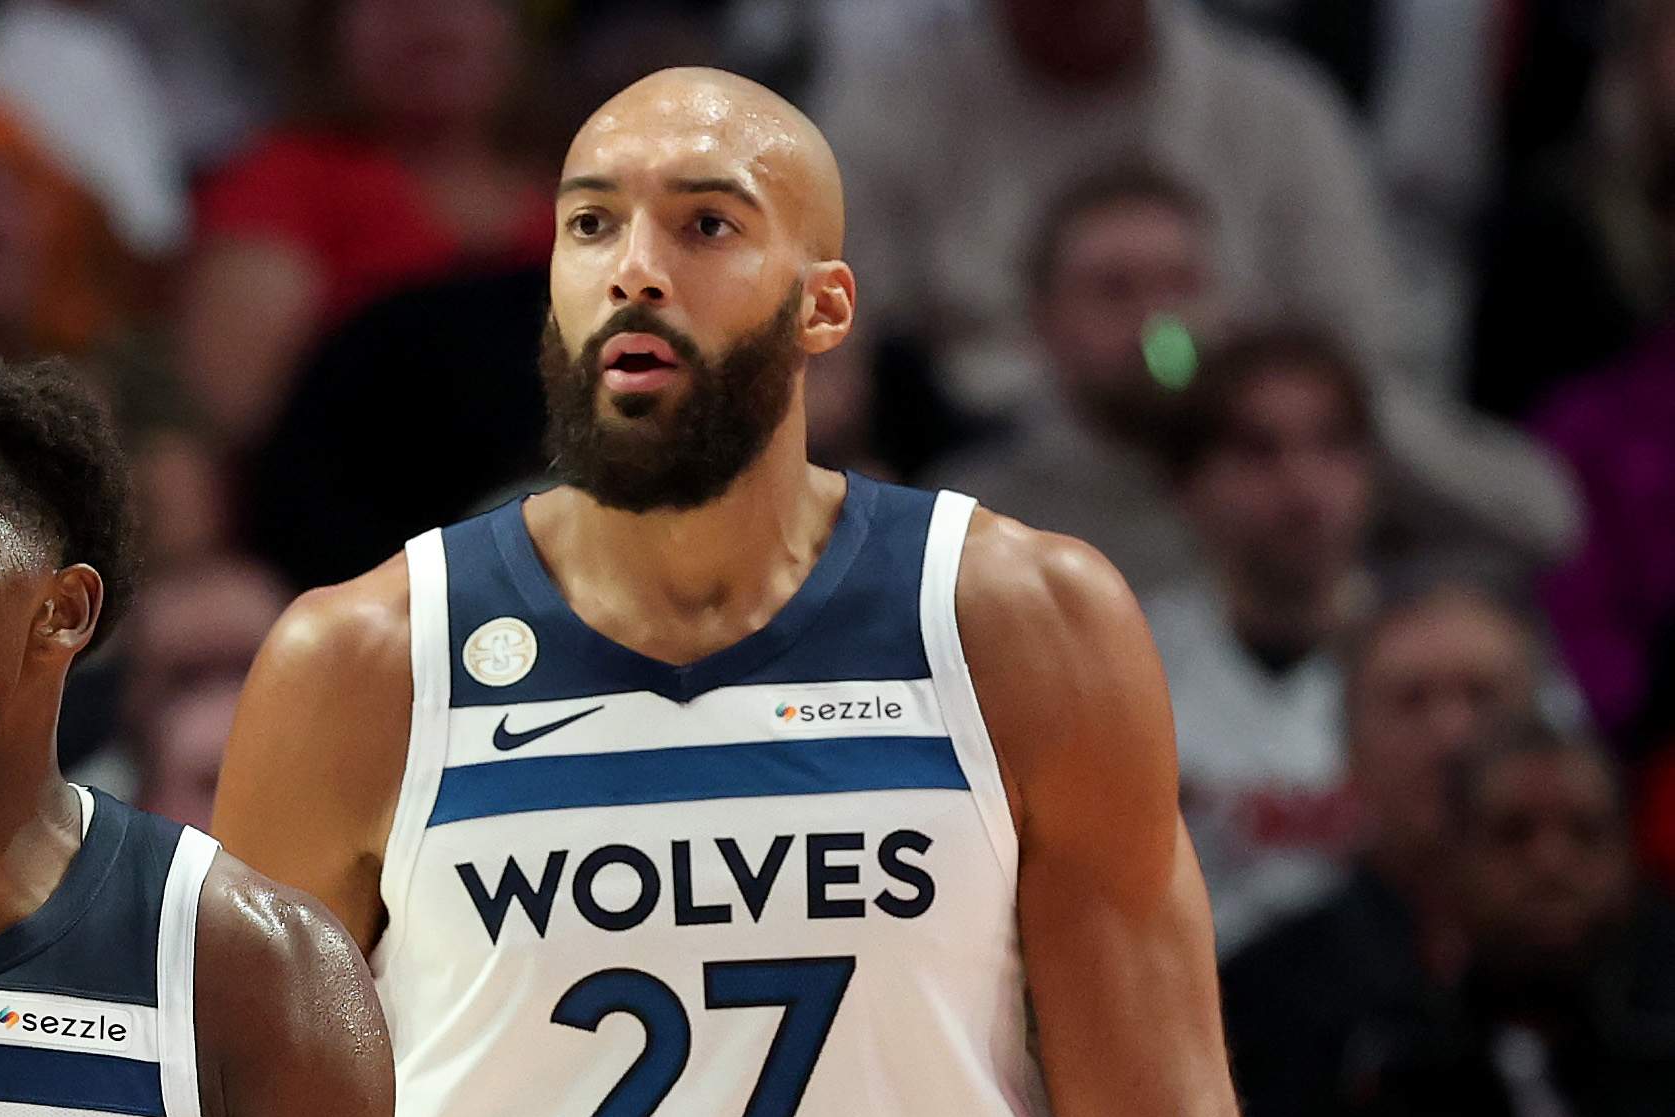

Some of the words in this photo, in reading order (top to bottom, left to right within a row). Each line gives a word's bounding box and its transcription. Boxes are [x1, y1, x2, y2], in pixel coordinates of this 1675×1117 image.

[800, 695, 902, 721] sezzle
[455, 830, 935, 945] WOLVES
[22, 1012, 127, 1042] sezzle
